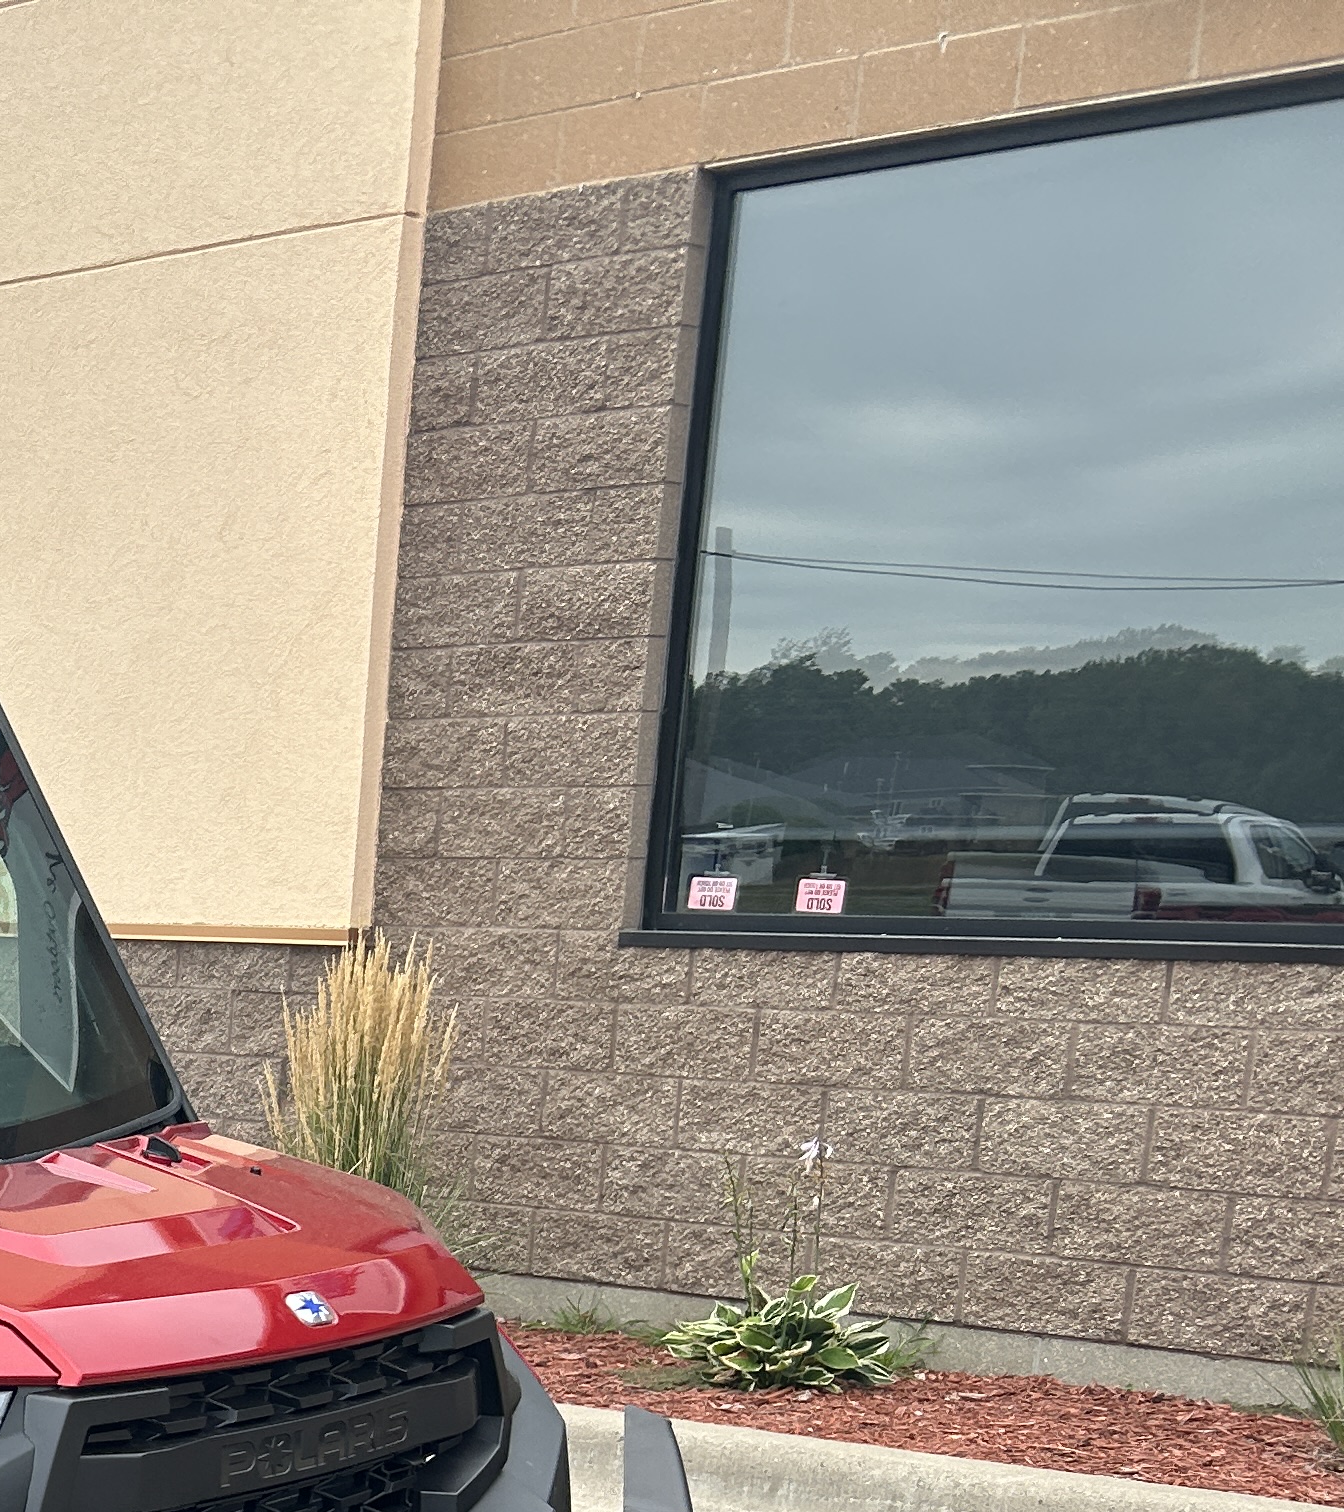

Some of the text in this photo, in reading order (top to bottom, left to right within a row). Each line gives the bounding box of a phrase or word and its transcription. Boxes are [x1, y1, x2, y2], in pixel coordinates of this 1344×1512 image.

[699, 894, 725, 908] SOLD
[806, 897, 832, 911] SOLD
[220, 1407, 409, 1488] POLARIS
